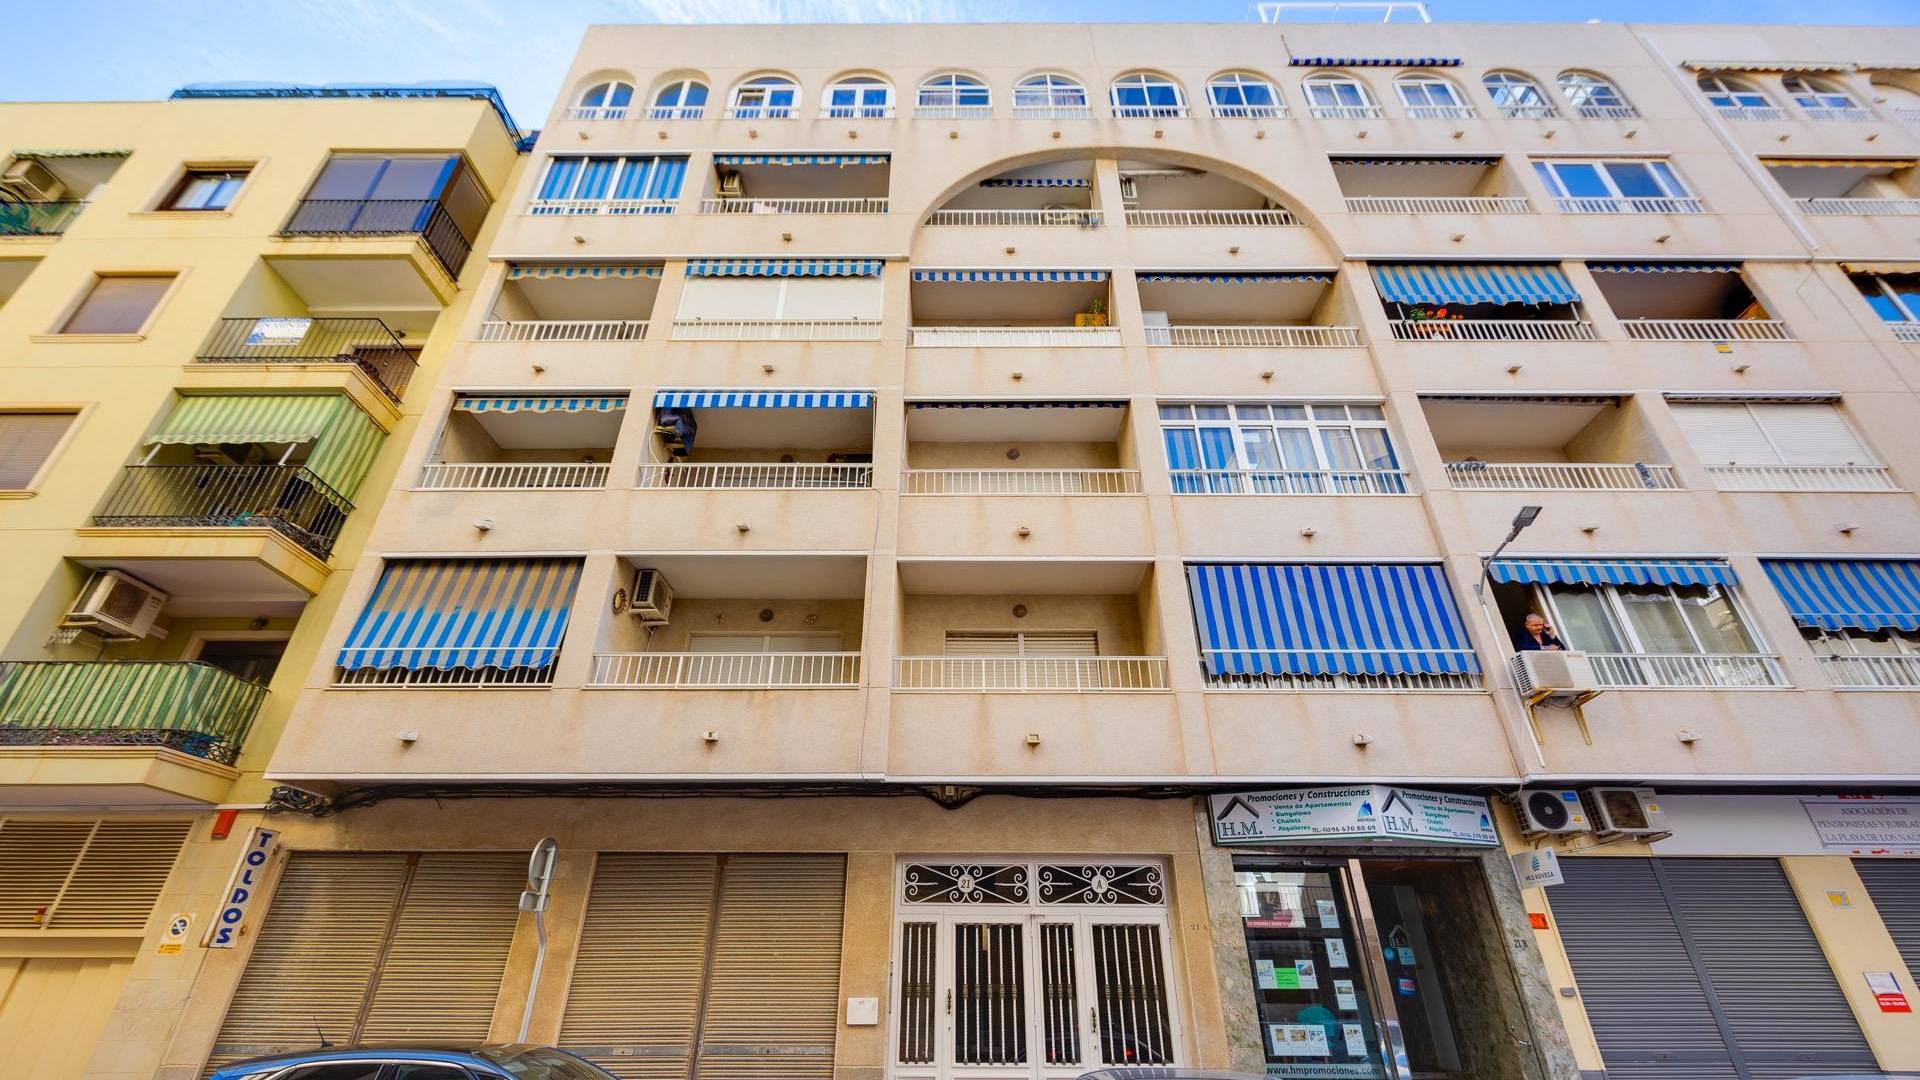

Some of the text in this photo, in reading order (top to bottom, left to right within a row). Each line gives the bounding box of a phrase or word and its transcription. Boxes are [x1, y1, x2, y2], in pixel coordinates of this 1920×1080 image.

[1247, 788, 1370, 802] Promociones y Construcciones
[1402, 791, 1485, 807] Promociones y Construcciones
[1304, 801, 1352, 810] Apartamentos
[1275, 810, 1311, 818] Bungalows
[1221, 820, 1263, 837] H.M.
[1385, 815, 1419, 833] H.M.
[215, 832, 273, 944] TOLDOS
[961, 879, 971, 888] 21
[1096, 880, 1103, 890] A
[1513, 939, 1528, 948] 21 B
[1266, 1065, 1381, 1077] www.hmpromociones.com
